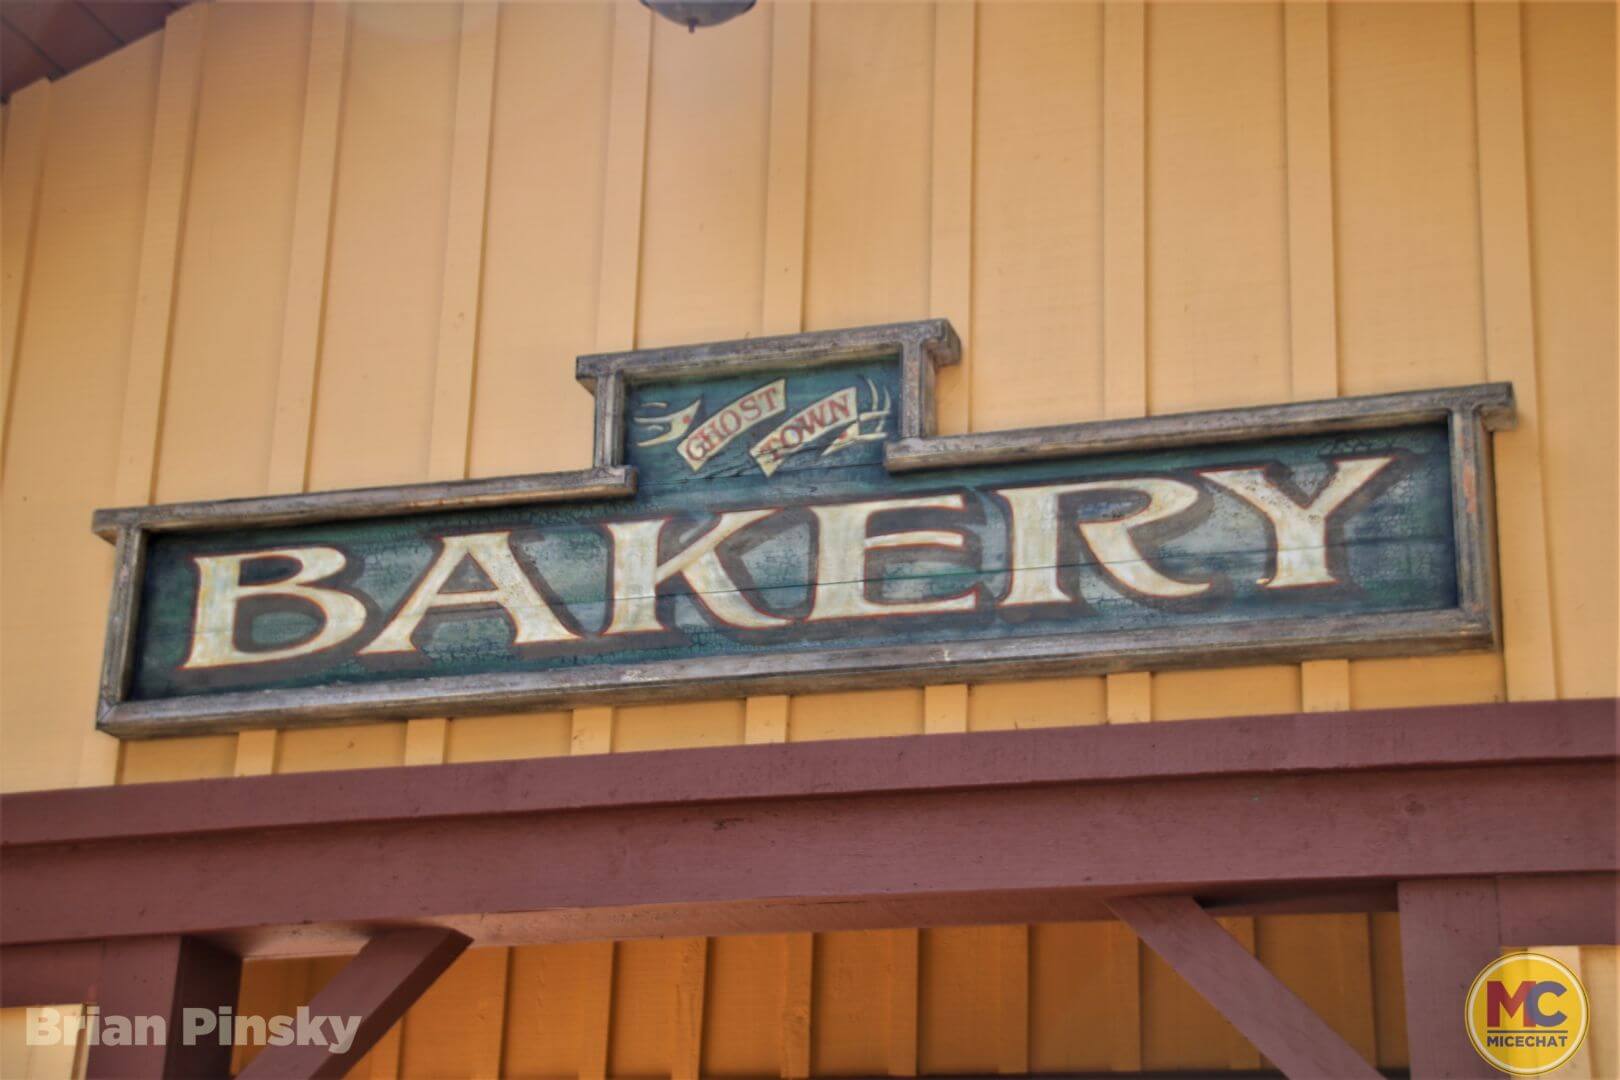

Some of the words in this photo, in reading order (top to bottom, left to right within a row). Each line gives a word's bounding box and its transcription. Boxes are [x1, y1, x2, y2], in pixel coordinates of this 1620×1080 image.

[685, 387, 779, 461] GHOST
[759, 394, 852, 462] TOWN
[181, 455, 1398, 671] BAKERY
